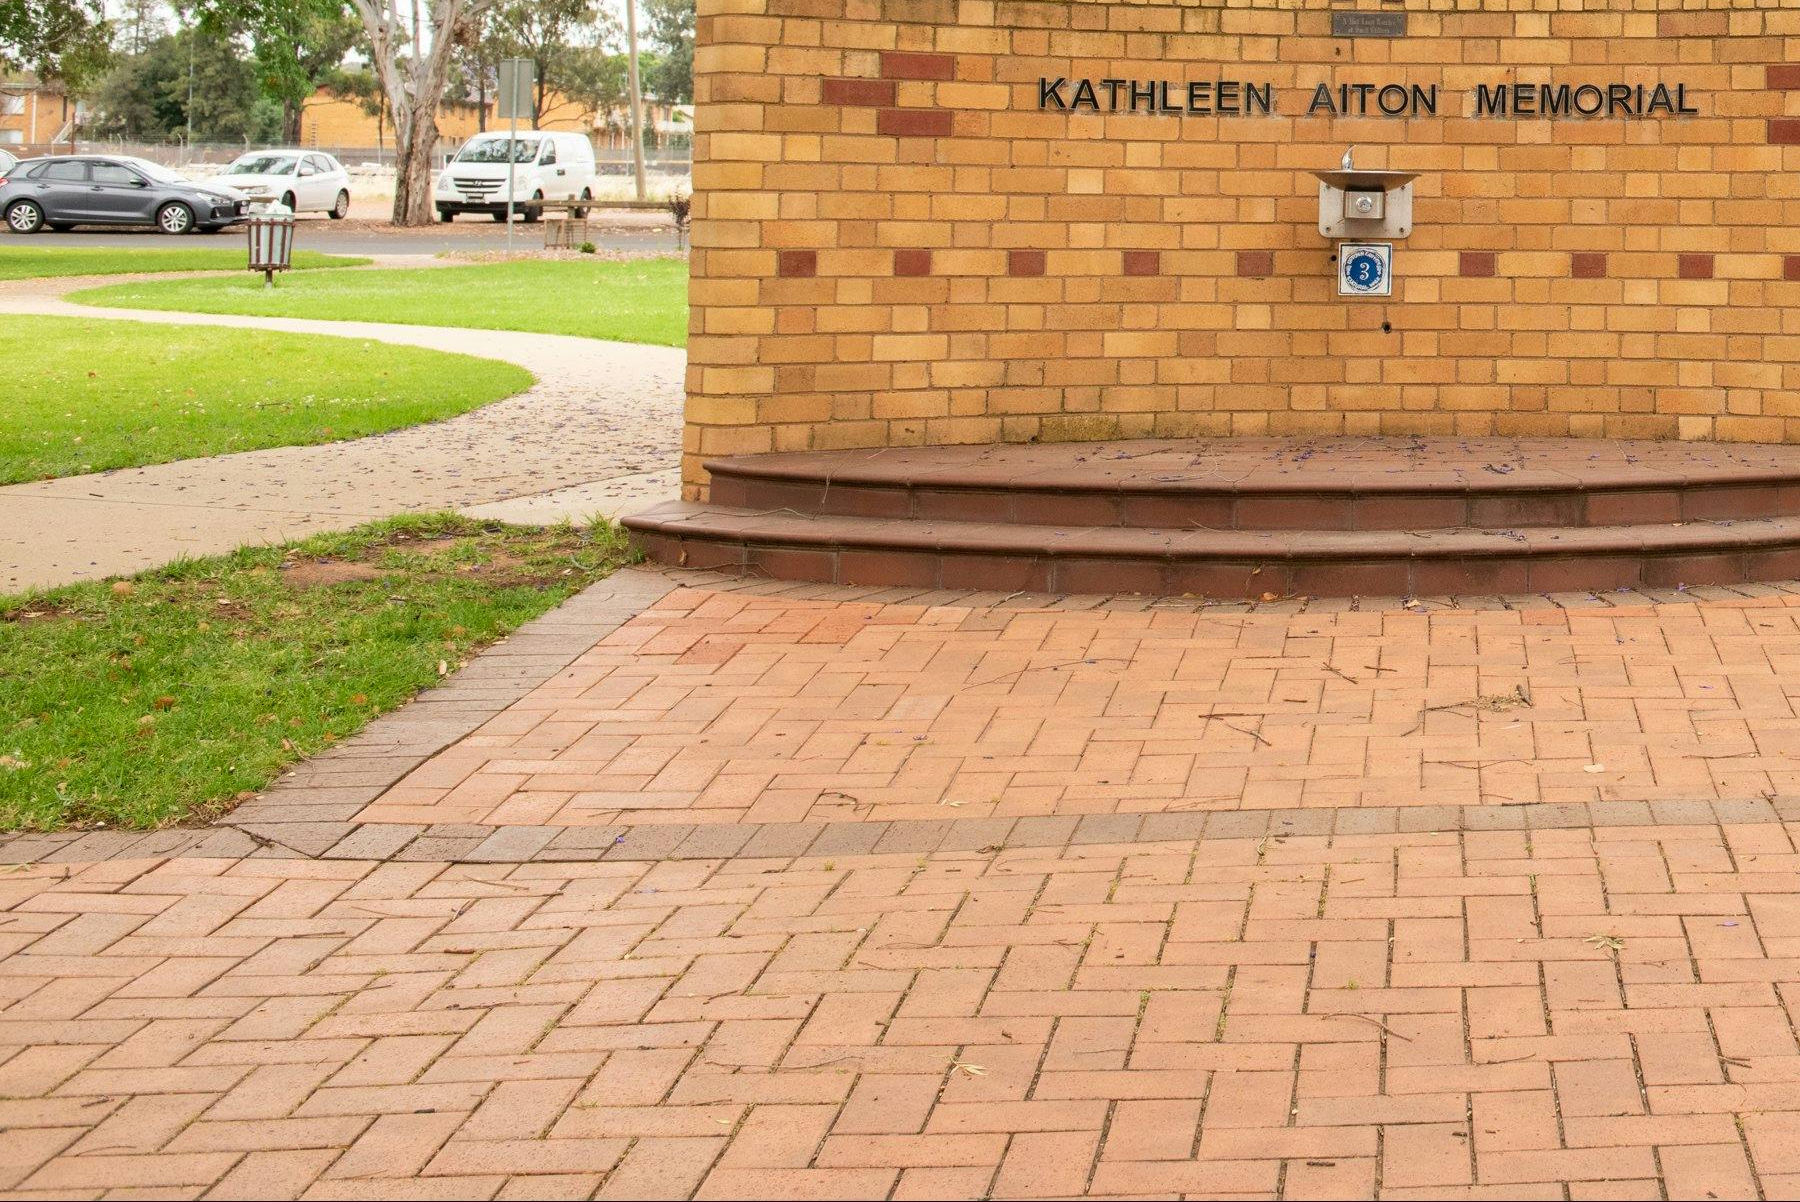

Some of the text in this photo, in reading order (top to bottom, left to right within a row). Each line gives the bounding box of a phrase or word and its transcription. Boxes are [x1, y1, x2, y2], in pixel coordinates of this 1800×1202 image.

[1038, 77, 1699, 116] KATHLEEN AITON MEMORIAL
[1359, 262, 1370, 281] 3
